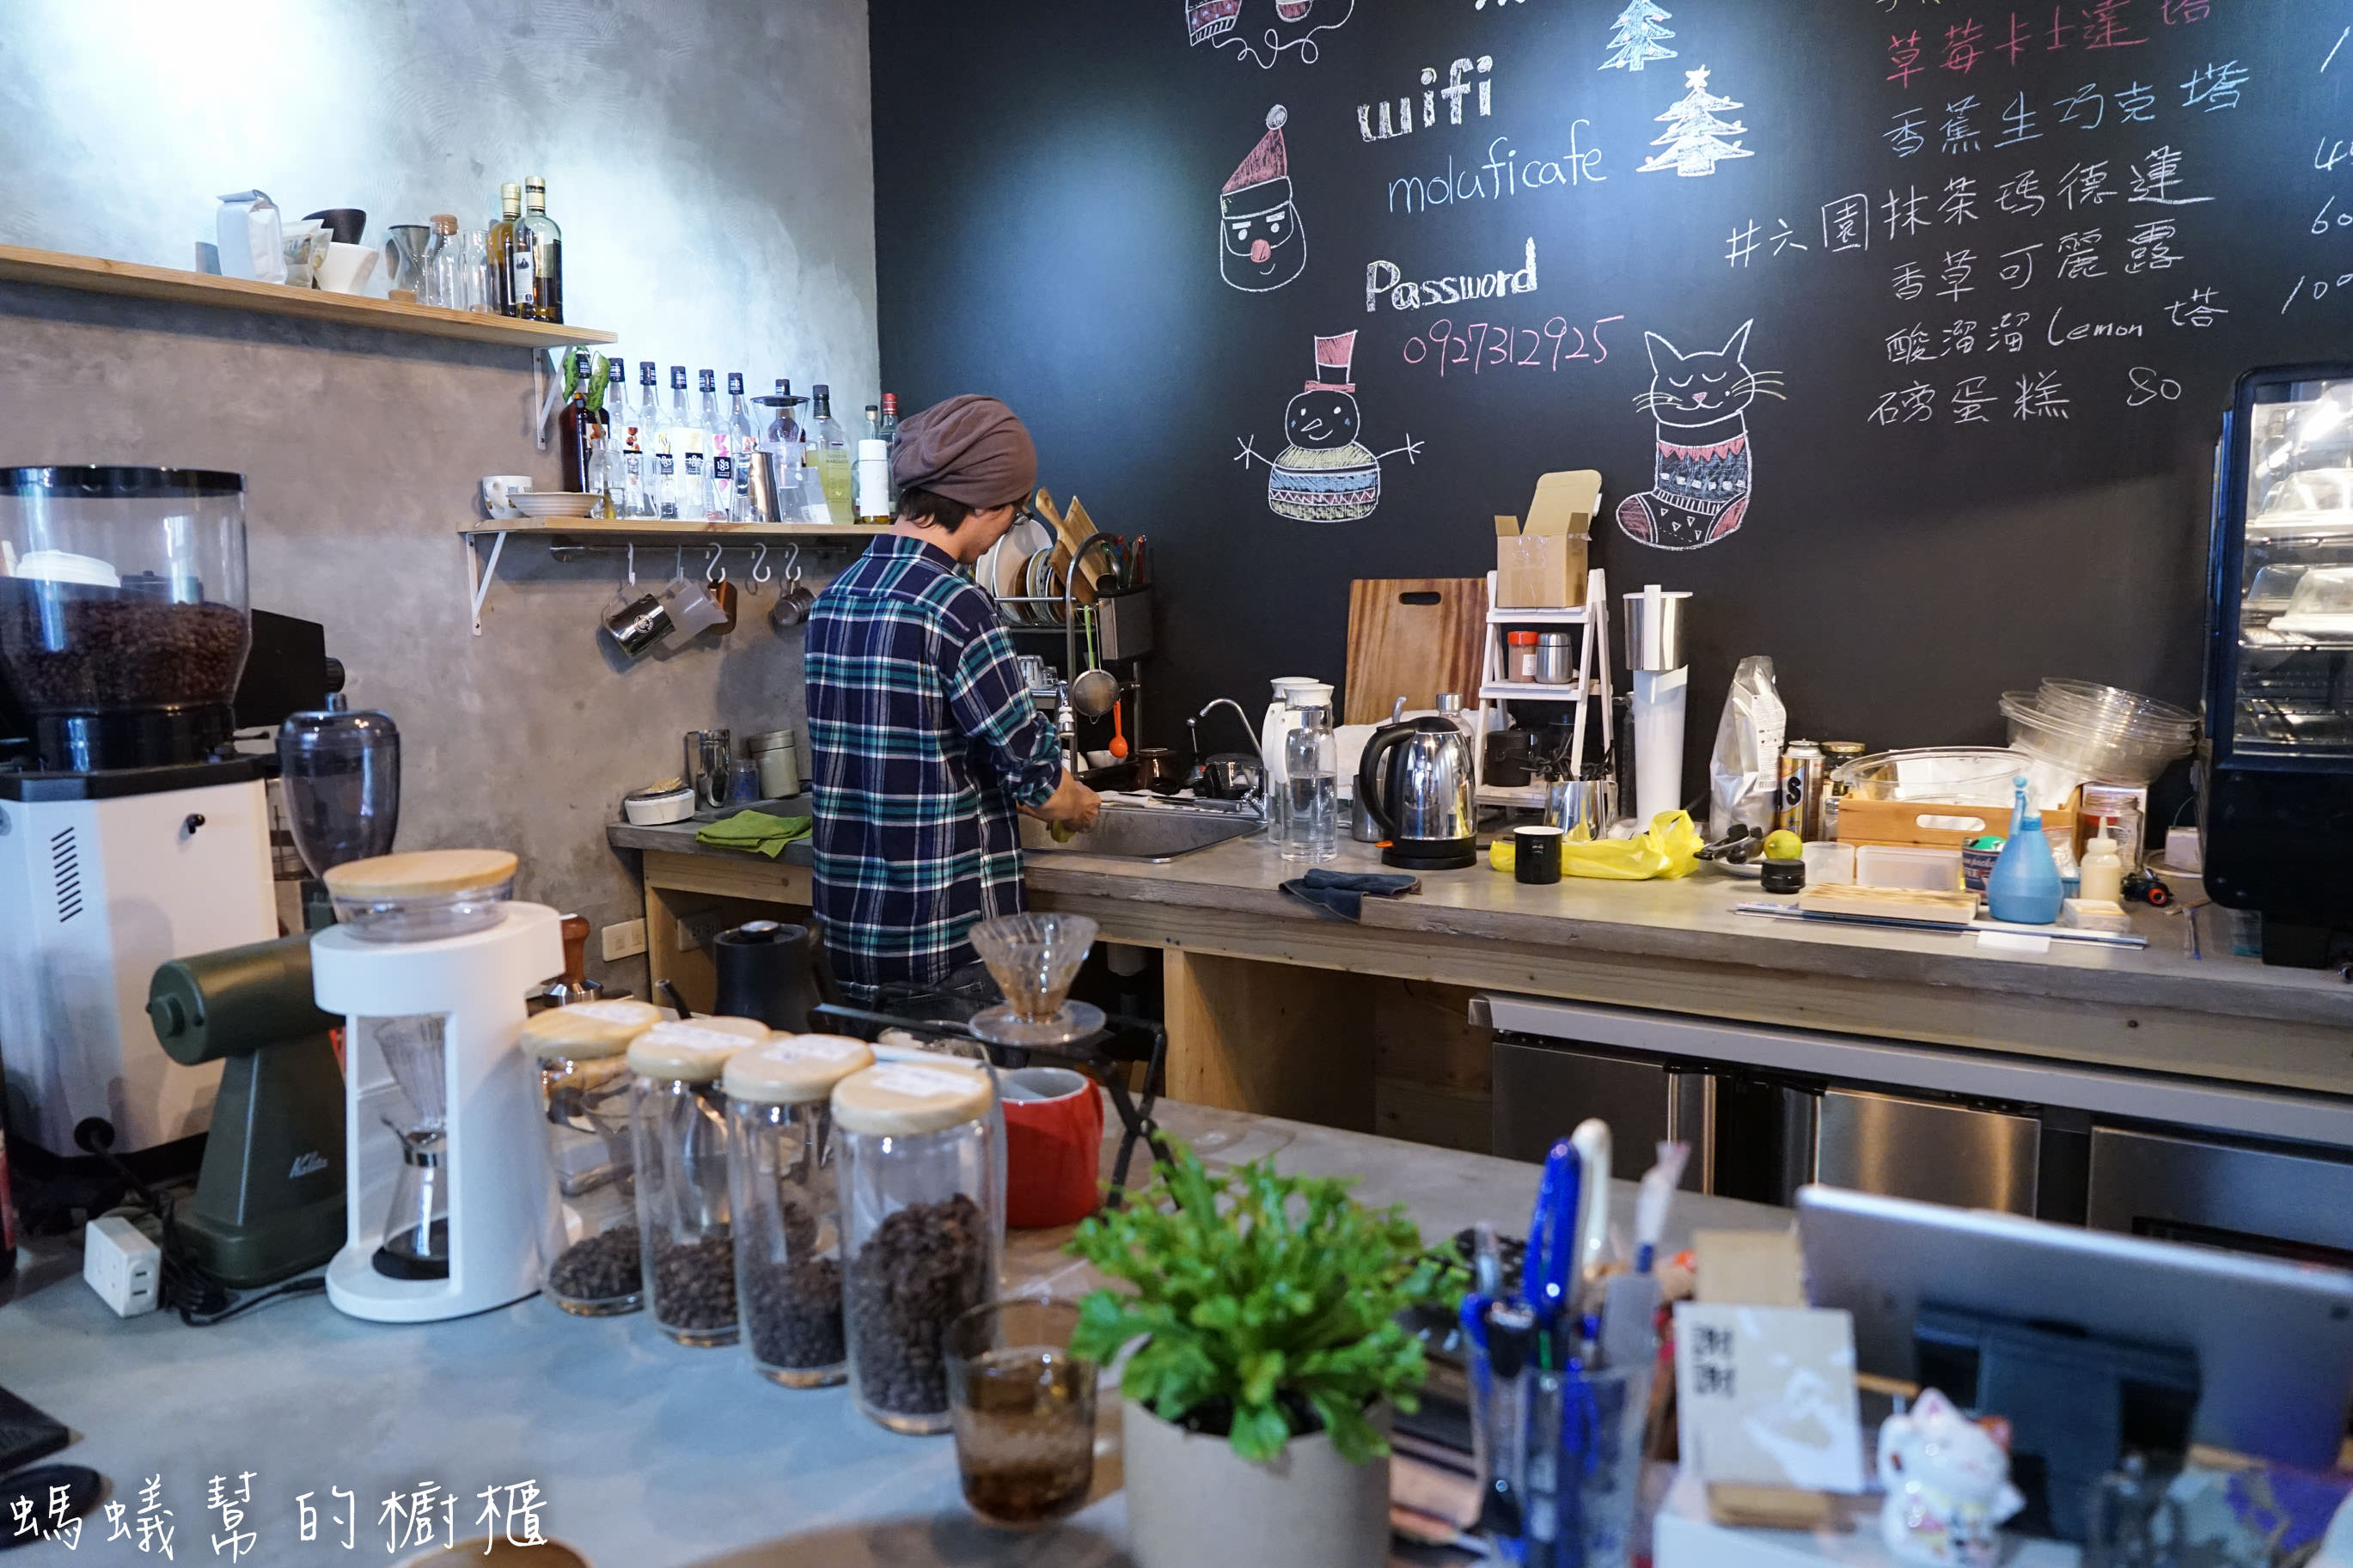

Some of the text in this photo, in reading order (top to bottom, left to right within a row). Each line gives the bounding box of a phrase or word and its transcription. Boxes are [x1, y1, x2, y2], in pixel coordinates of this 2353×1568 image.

[1357, 55, 1494, 143] wifi
[1389, 119, 1608, 214] moluficafe
[1366, 237, 1537, 312] Password
[1892, 218, 2185, 302] 香草可麗露
[1403, 314, 1624, 376] 0927312925
[1885, 312, 2030, 365] 酸溜溜
[2164, 287, 2229, 328] 塔
[1867, 367, 2182, 426] 磅蛋糕 80
